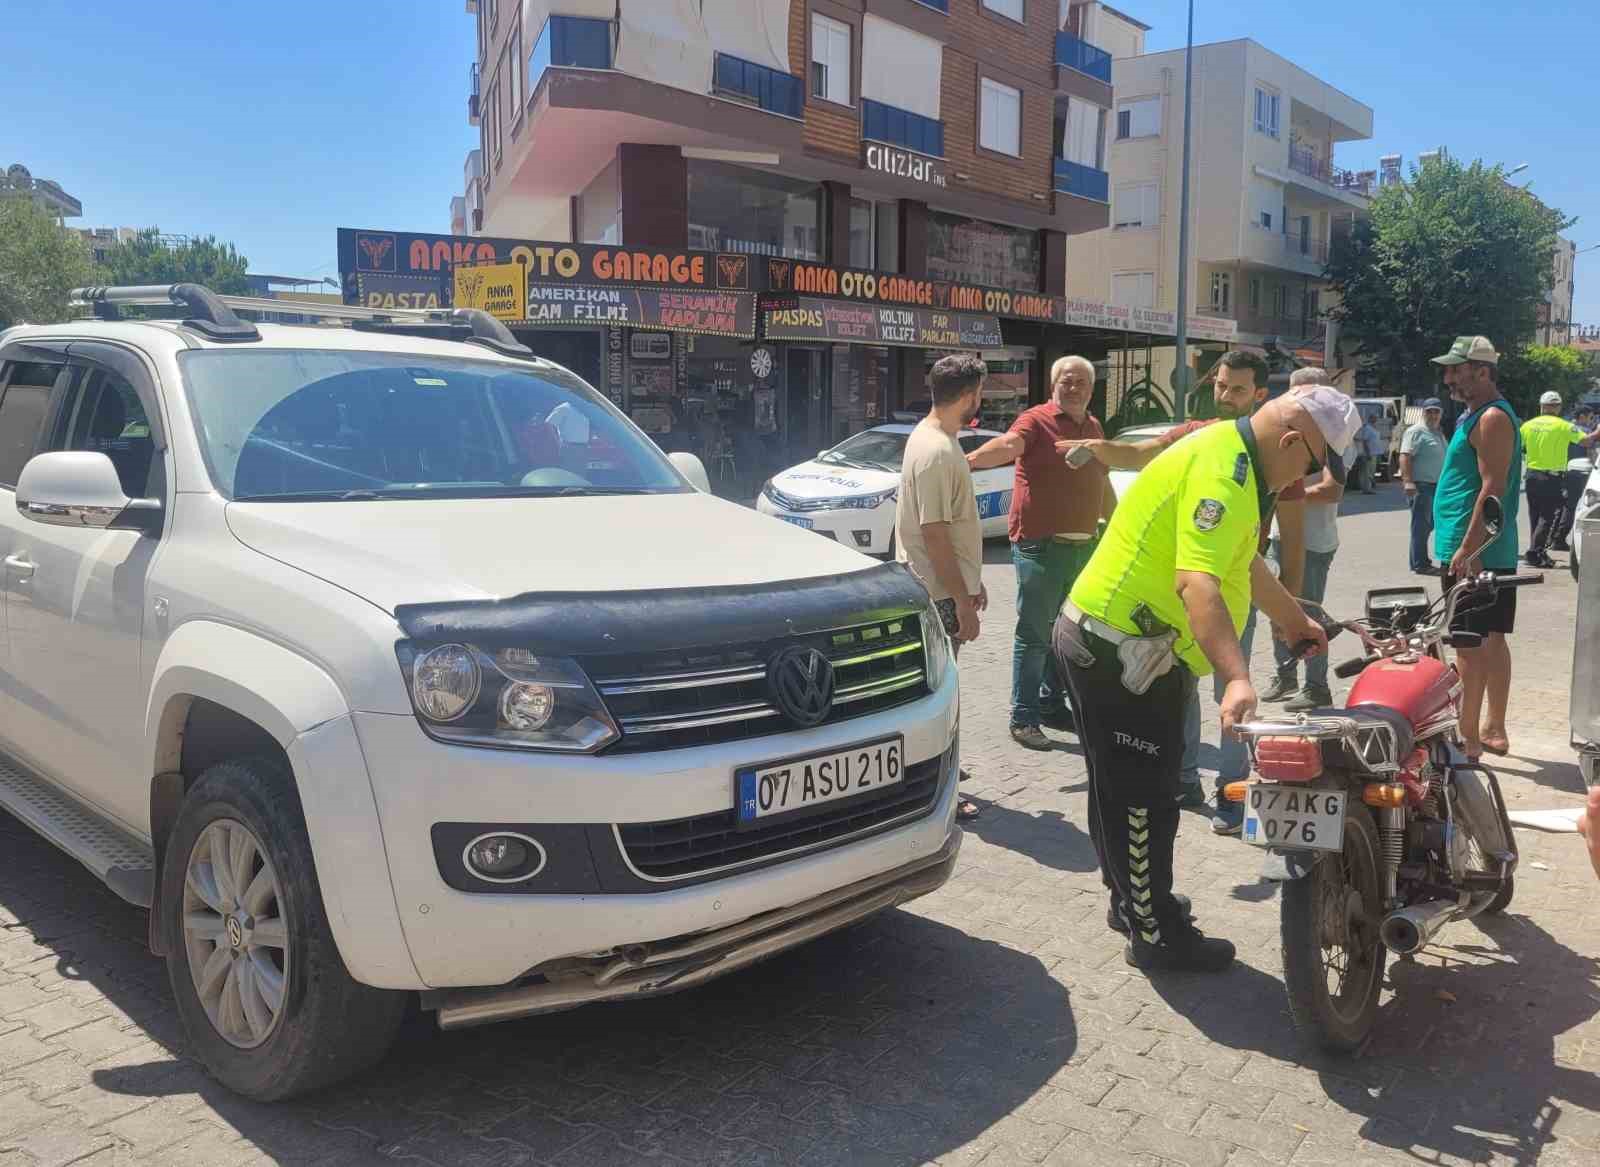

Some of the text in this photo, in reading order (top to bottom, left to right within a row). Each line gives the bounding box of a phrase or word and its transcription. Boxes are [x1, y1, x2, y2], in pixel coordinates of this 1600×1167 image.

[410, 239, 705, 284] ANKA OTO GARAGE
[487, 285, 513, 298] ANKA
[529, 285, 620, 303] AMERİKAN
[794, 264, 933, 305] ANKA OTO GARAGE
[367, 291, 440, 309] PASTA
[484, 298, 516, 312] GARAGE
[950, 286, 1053, 318] ANKA OTO GARAGE
[527, 301, 629, 321] CAM FİLMİ
[772, 308, 823, 327] PASPAS
[880, 309, 914, 326] KOLTUK
[932, 314, 949, 329] FAR
[758, 745, 899, 811] 07 ASU 216
[1264, 818, 1317, 843] 076
